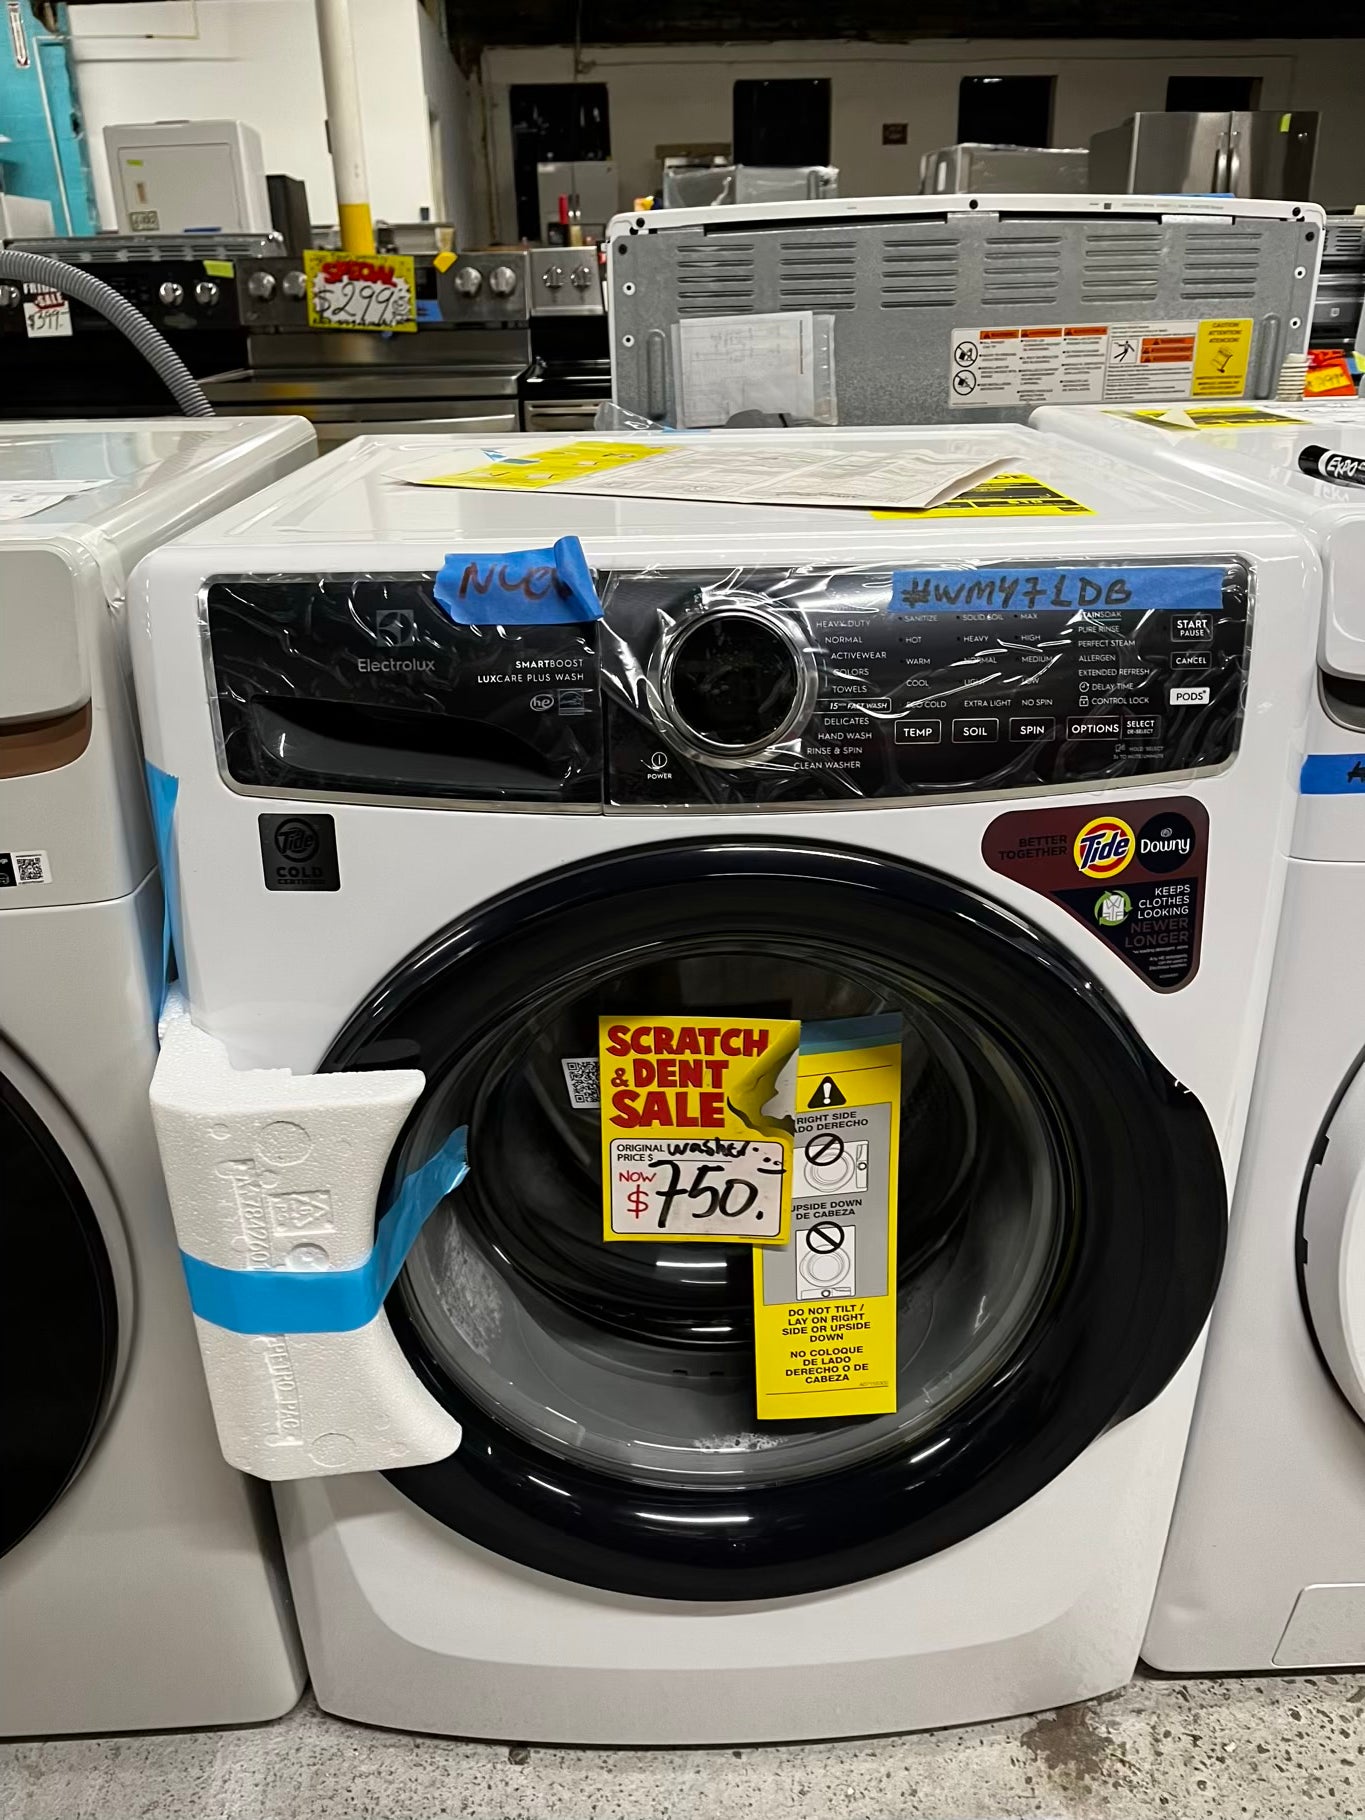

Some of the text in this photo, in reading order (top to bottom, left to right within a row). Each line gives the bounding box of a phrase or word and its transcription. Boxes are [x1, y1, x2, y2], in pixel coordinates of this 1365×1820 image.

[904, 614, 938, 622] SANITIZE
[1079, 611, 1122, 619] TAINSOAK
[816, 619, 871, 628] HEAVY DUTY
[1177, 619, 1208, 629] START
[1099, 625, 1120, 633] RINSE
[1180, 629, 1204, 637] PAUSE
[825, 636, 863, 644] NORMAL
[963, 635, 989, 643] HEAVY
[1078, 639, 1136, 648] PERFECT STEAM
[831, 651, 887, 660] ACTIVEWEAR
[1021, 655, 1053, 663] MEDIUM
[1079, 654, 1116, 662] ALLERGEN
[1175, 656, 1207, 665] CANCEL
[358, 657, 436, 672] Electrolux
[515, 658, 584, 669] SMARTBOOST
[1078, 668, 1150, 677] EXTENDED REFRESH
[477, 672, 584, 684] LUXCARE PLUS WASH
[906, 679, 930, 687] COOL
[832, 685, 868, 693] TOWELS
[1092, 682, 1134, 691] DELAY TIME
[1091, 696, 1150, 705] CONTROL LOCK
[1176, 692, 1204, 701] PODS
[924, 700, 947, 709] COLD
[964, 699, 1012, 707] EXTRA LIGHT
[1036, 698, 1053, 706] SPIN
[824, 717, 870, 726] DELICATES
[1126, 719, 1156, 728] SELECT
[903, 727, 933, 737] TEMP
[963, 726, 988, 737] SOIL
[1019, 725, 1045, 735] SPIN
[1071, 724, 1120, 734] OPTIONS
[817, 731, 873, 740] HAND WASH
[806, 747, 832, 755] RINSE
[842, 746, 863, 754] SPIN
[793, 760, 861, 770] CLEAN WASHER
[1019, 834, 1068, 848] BETTER
[1140, 837, 1191, 854] Downy
[999, 846, 1068, 861] TOGETHER
[1078, 829, 1131, 871] Tide
[276, 866, 324, 878] COLD
[1154, 884, 1191, 896] KEEPS
[1138, 896, 1190, 909] CLOTHES
[1137, 906, 1190, 919] LOOKING
[1130, 917, 1189, 933] NEWER
[1124, 931, 1189, 948] LONGER
[605, 1024, 769, 1057] SCRATCH
[610, 1058, 730, 1089] & DENT
[609, 1089, 726, 1128] SALE
[796, 1111, 858, 1125] RIGHT SIDE
[816, 1118, 869, 1131] DERECHO
[617, 1143, 666, 1153] ORIGINAL
[617, 1153, 646, 1162] PRICE
[619, 1169, 657, 1183] NOW
[830, 1198, 863, 1209] DOWN
[796, 1208, 856, 1220] DE CABEZA
[788, 1308, 805, 1317] DO
[808, 1306, 830, 1316] NOT
[834, 1304, 857, 1314] TILT
[788, 1312, 865, 1326] LAY ON RIGHT
[781, 1321, 871, 1336] SIDE OR UPSIDE
[809, 1333, 844, 1343] DOWN
[790, 1345, 864, 1359] NO COLOQUE
[802, 1355, 852, 1367] DE LADO
[785, 1362, 869, 1377] DERECHO O DE
[805, 1373, 850, 1385] CABEZA
